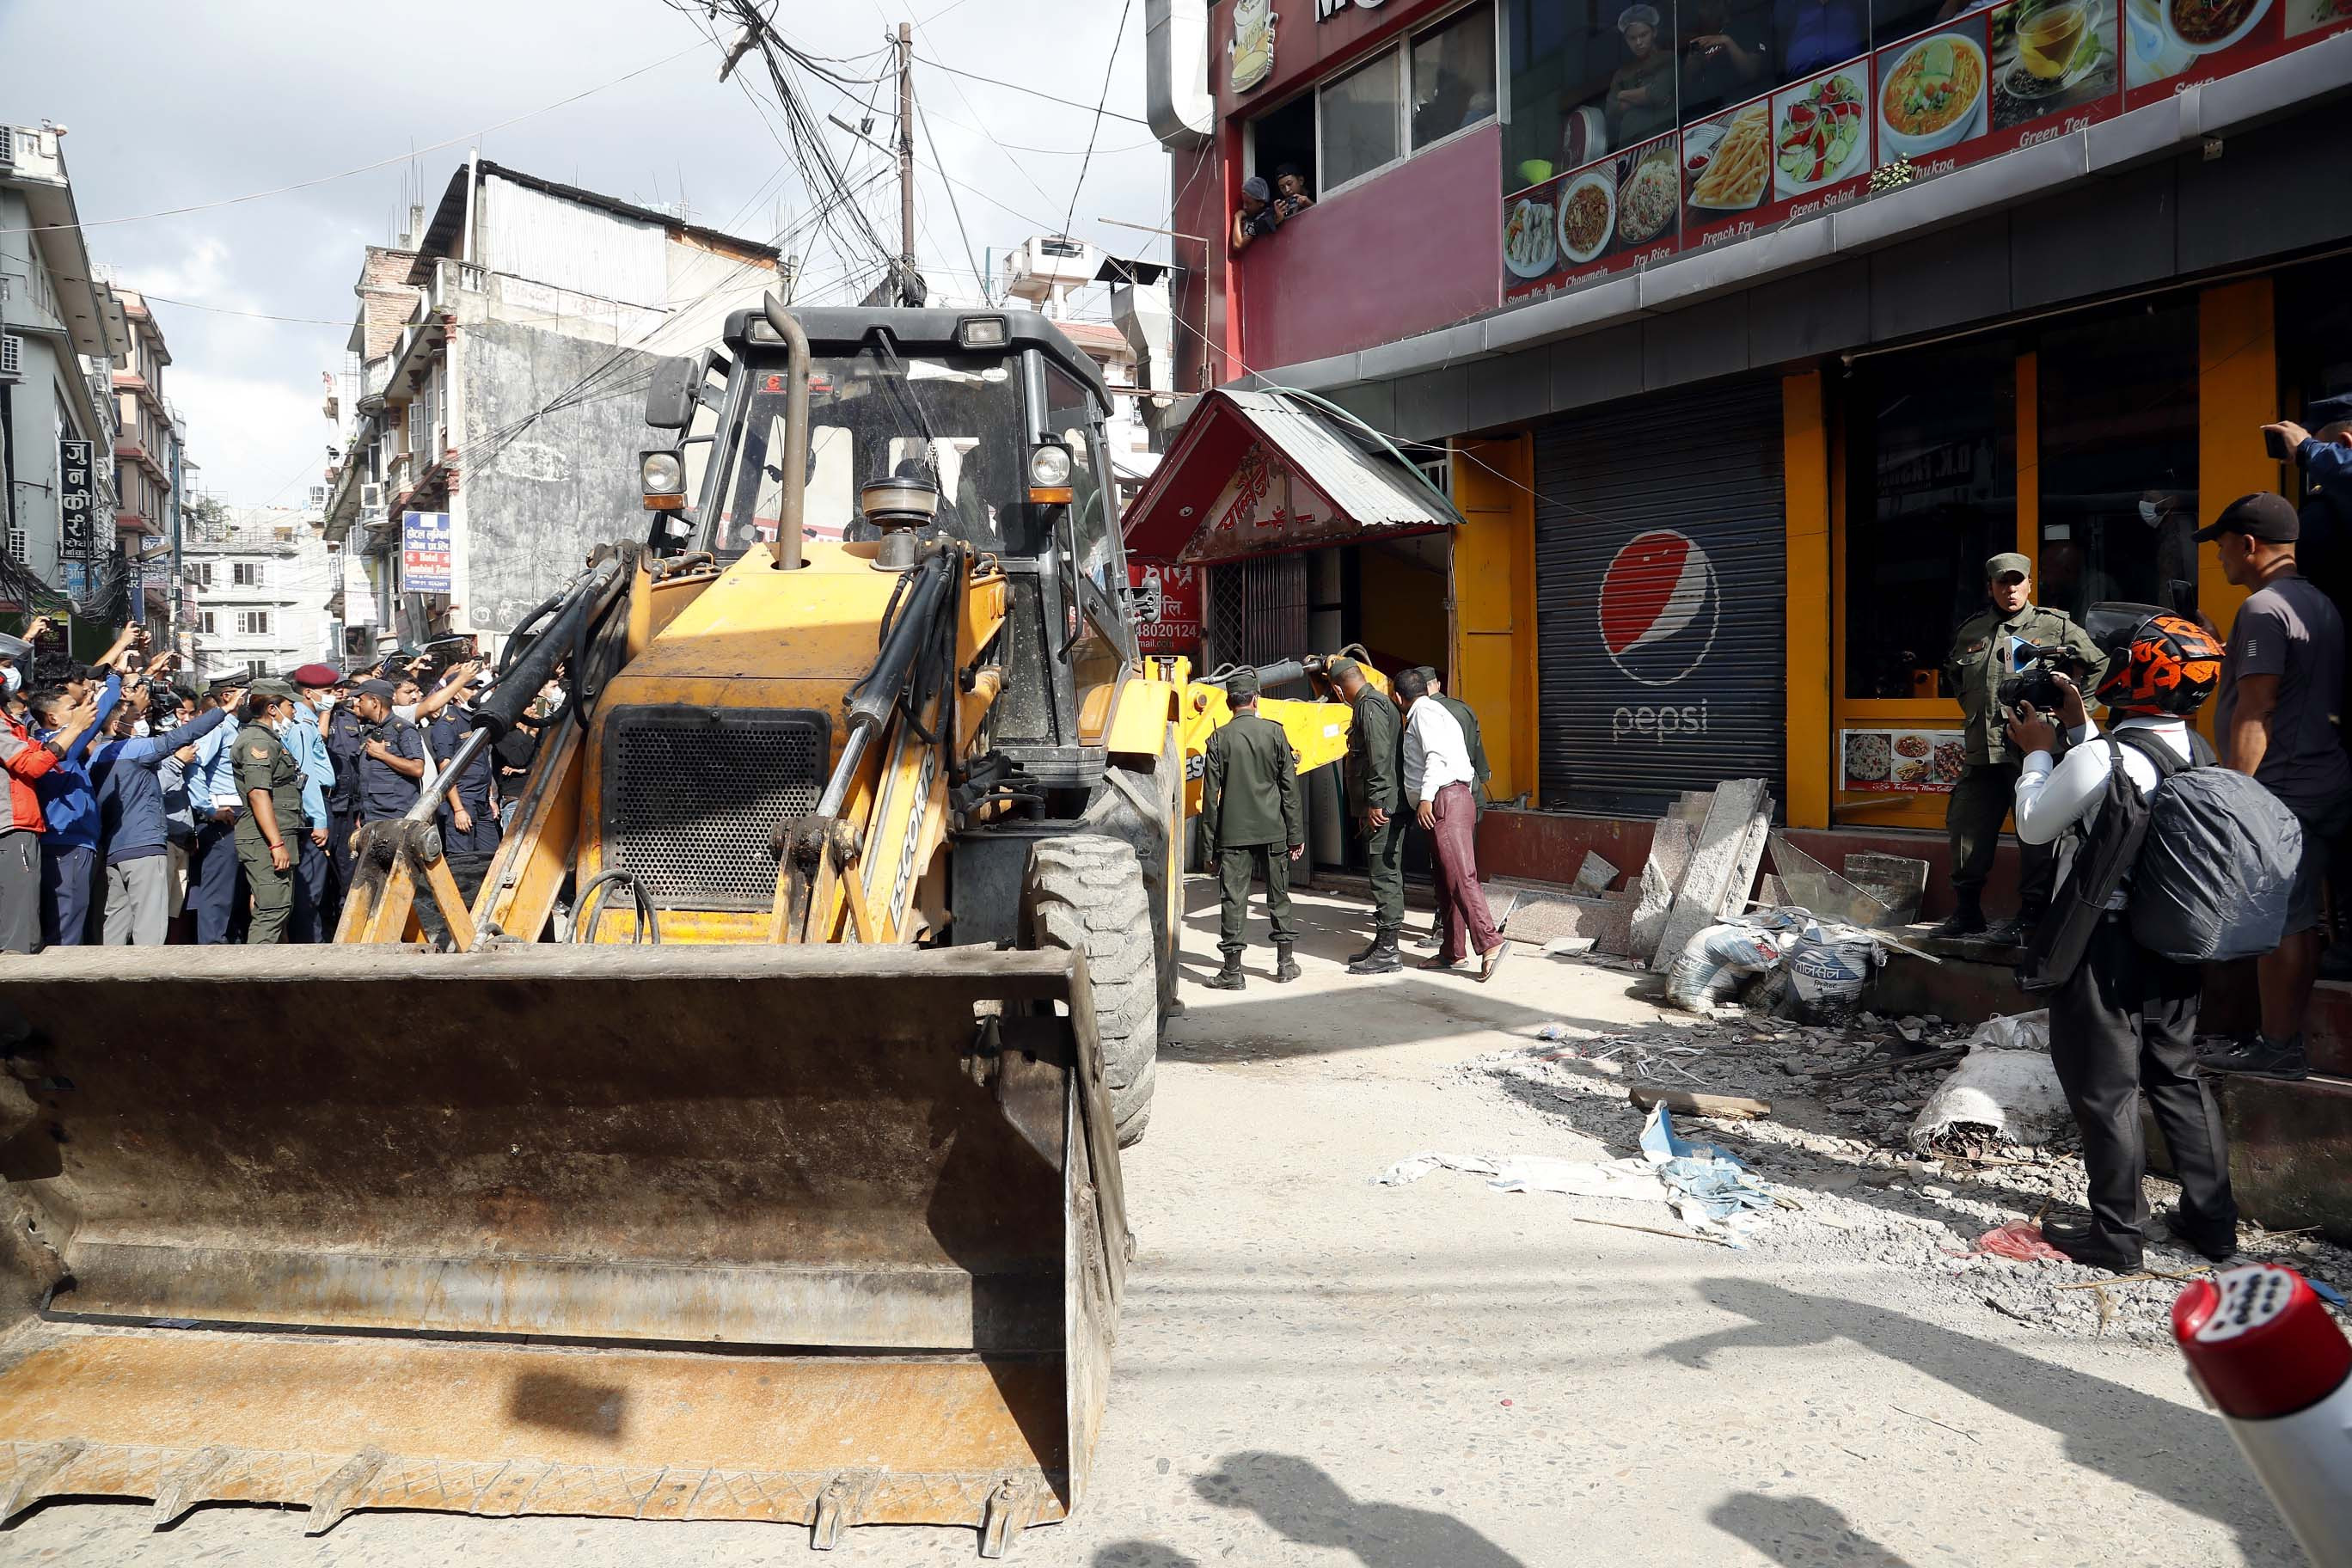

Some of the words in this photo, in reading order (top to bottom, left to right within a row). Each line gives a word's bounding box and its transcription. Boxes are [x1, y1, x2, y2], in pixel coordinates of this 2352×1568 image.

[2019, 124, 2059, 148] Green
[2064, 115, 2090, 132] Tea
[1790, 199, 1821, 217] Green
[1823, 186, 1857, 206] Salad
[1702, 230, 1735, 246] French
[1738, 220, 1755, 235] Fry
[1633, 254, 1649, 267] Fry
[1651, 247, 1670, 260] Rice
[1565, 267, 1608, 288] Chowmein
[1613, 698, 1708, 745] pepsi
[889, 742, 936, 934] ESCORTS
[1794, 959, 1841, 978] तानसेन
